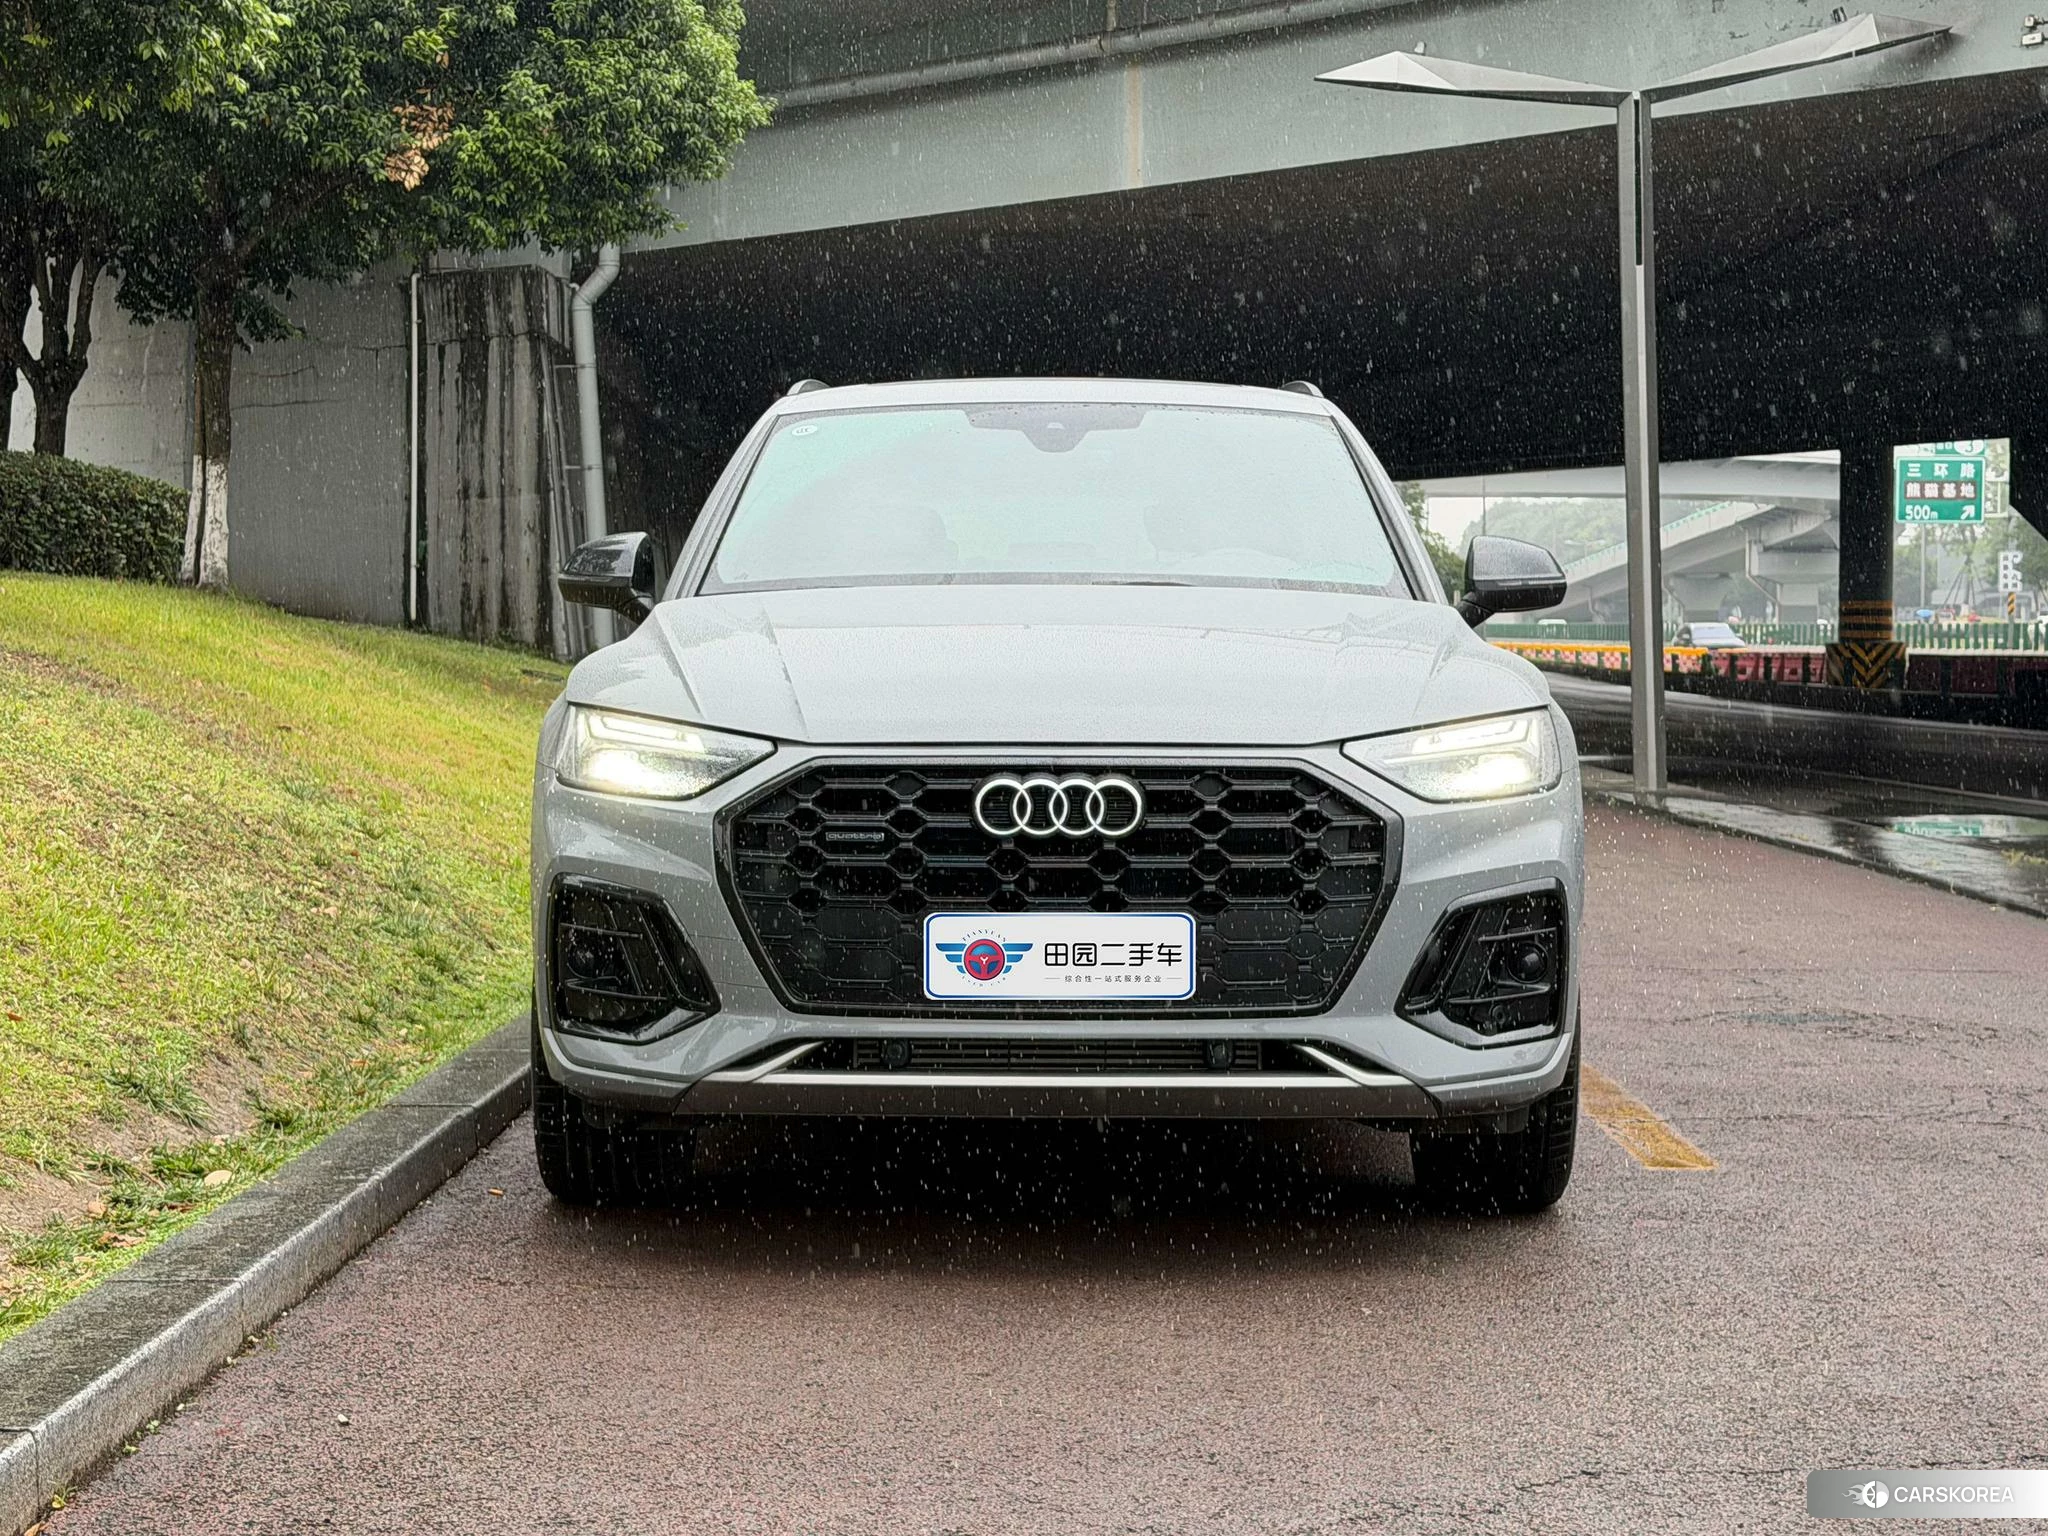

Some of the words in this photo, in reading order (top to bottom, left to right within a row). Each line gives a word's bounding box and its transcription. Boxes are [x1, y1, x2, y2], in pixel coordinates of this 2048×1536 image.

[1907, 463, 1975, 478] 三环路
[1905, 505, 1938, 519] 500m
[1045, 943, 1182, 966] 田园二手车
